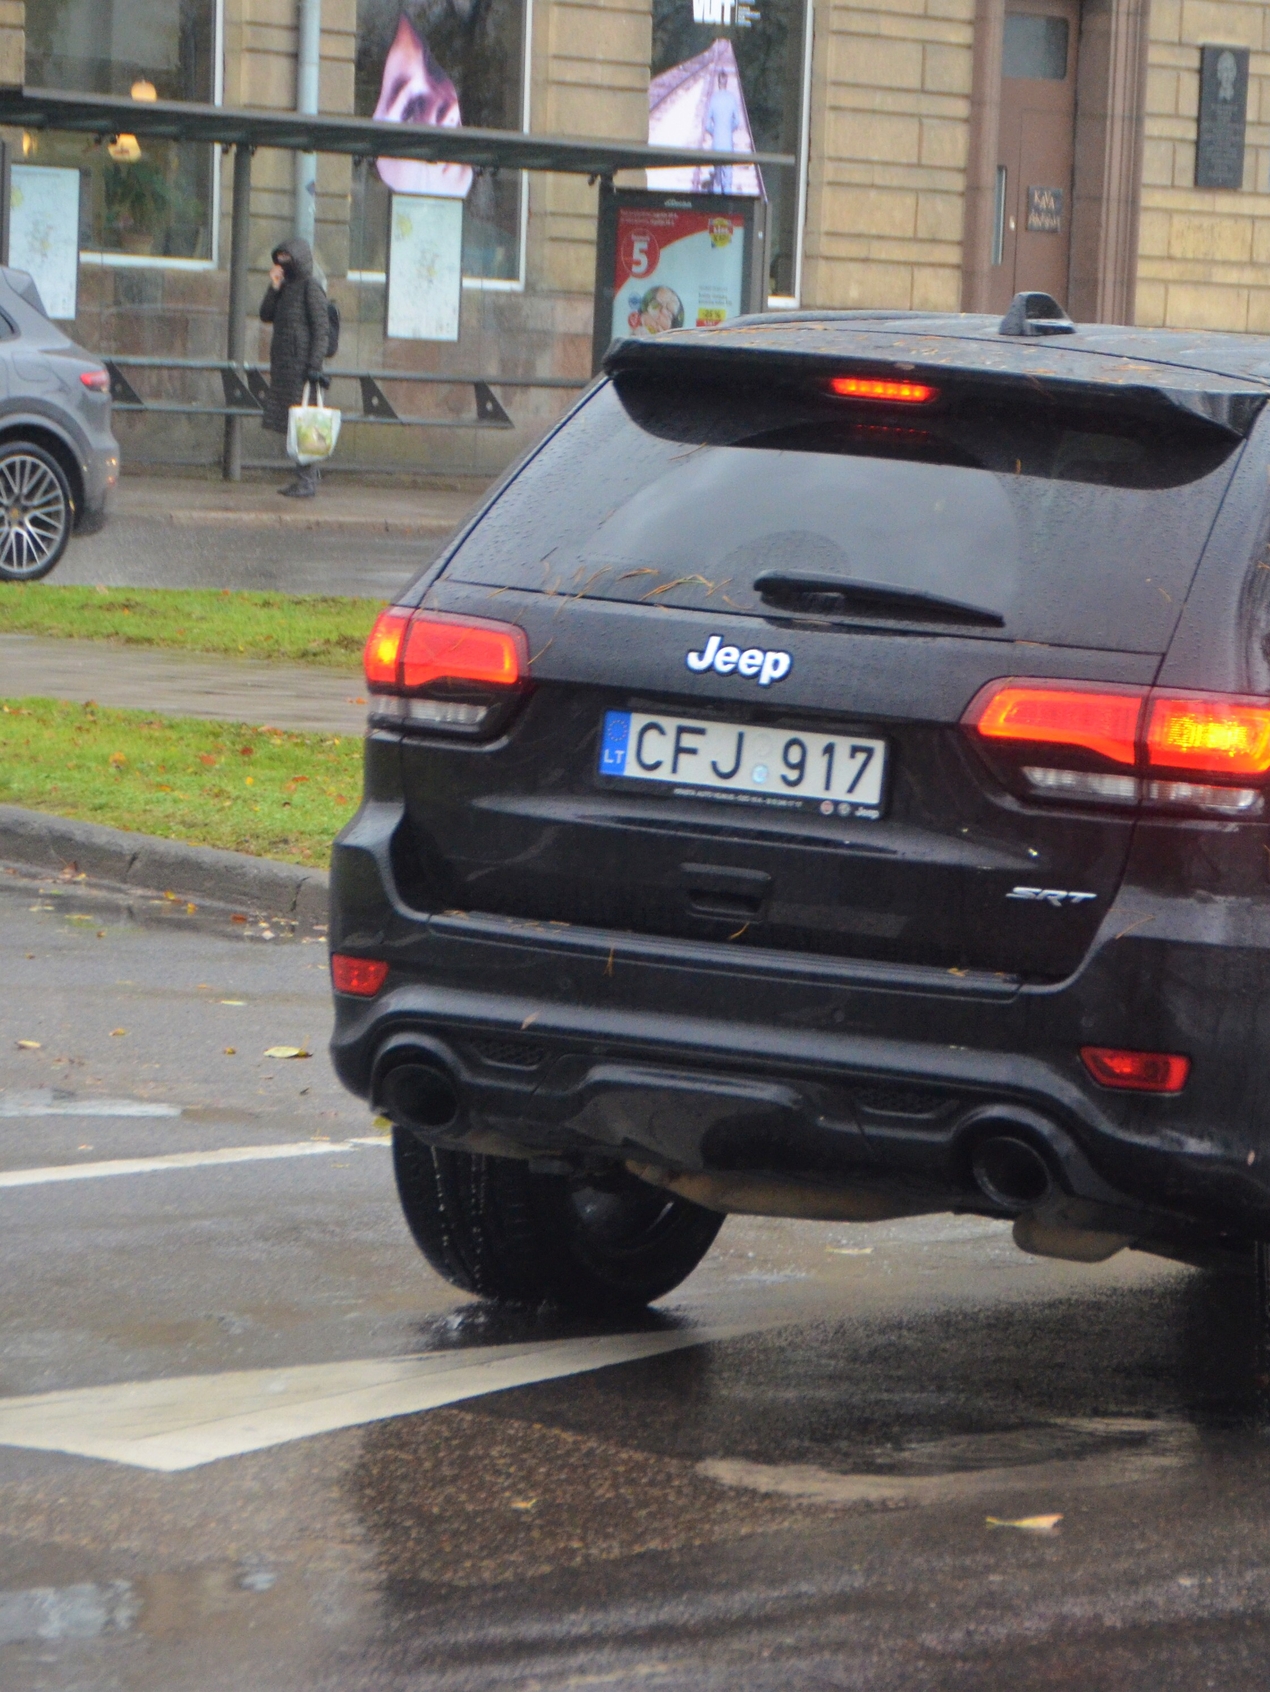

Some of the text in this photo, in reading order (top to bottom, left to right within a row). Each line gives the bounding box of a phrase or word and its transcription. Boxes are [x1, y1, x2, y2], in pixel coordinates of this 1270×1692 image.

[631, 241, 649, 274] 5
[687, 636, 791, 685] Jeep
[603, 748, 625, 765] LT
[636, 721, 875, 794] CFJ 917
[1005, 886, 1098, 907] SRT
